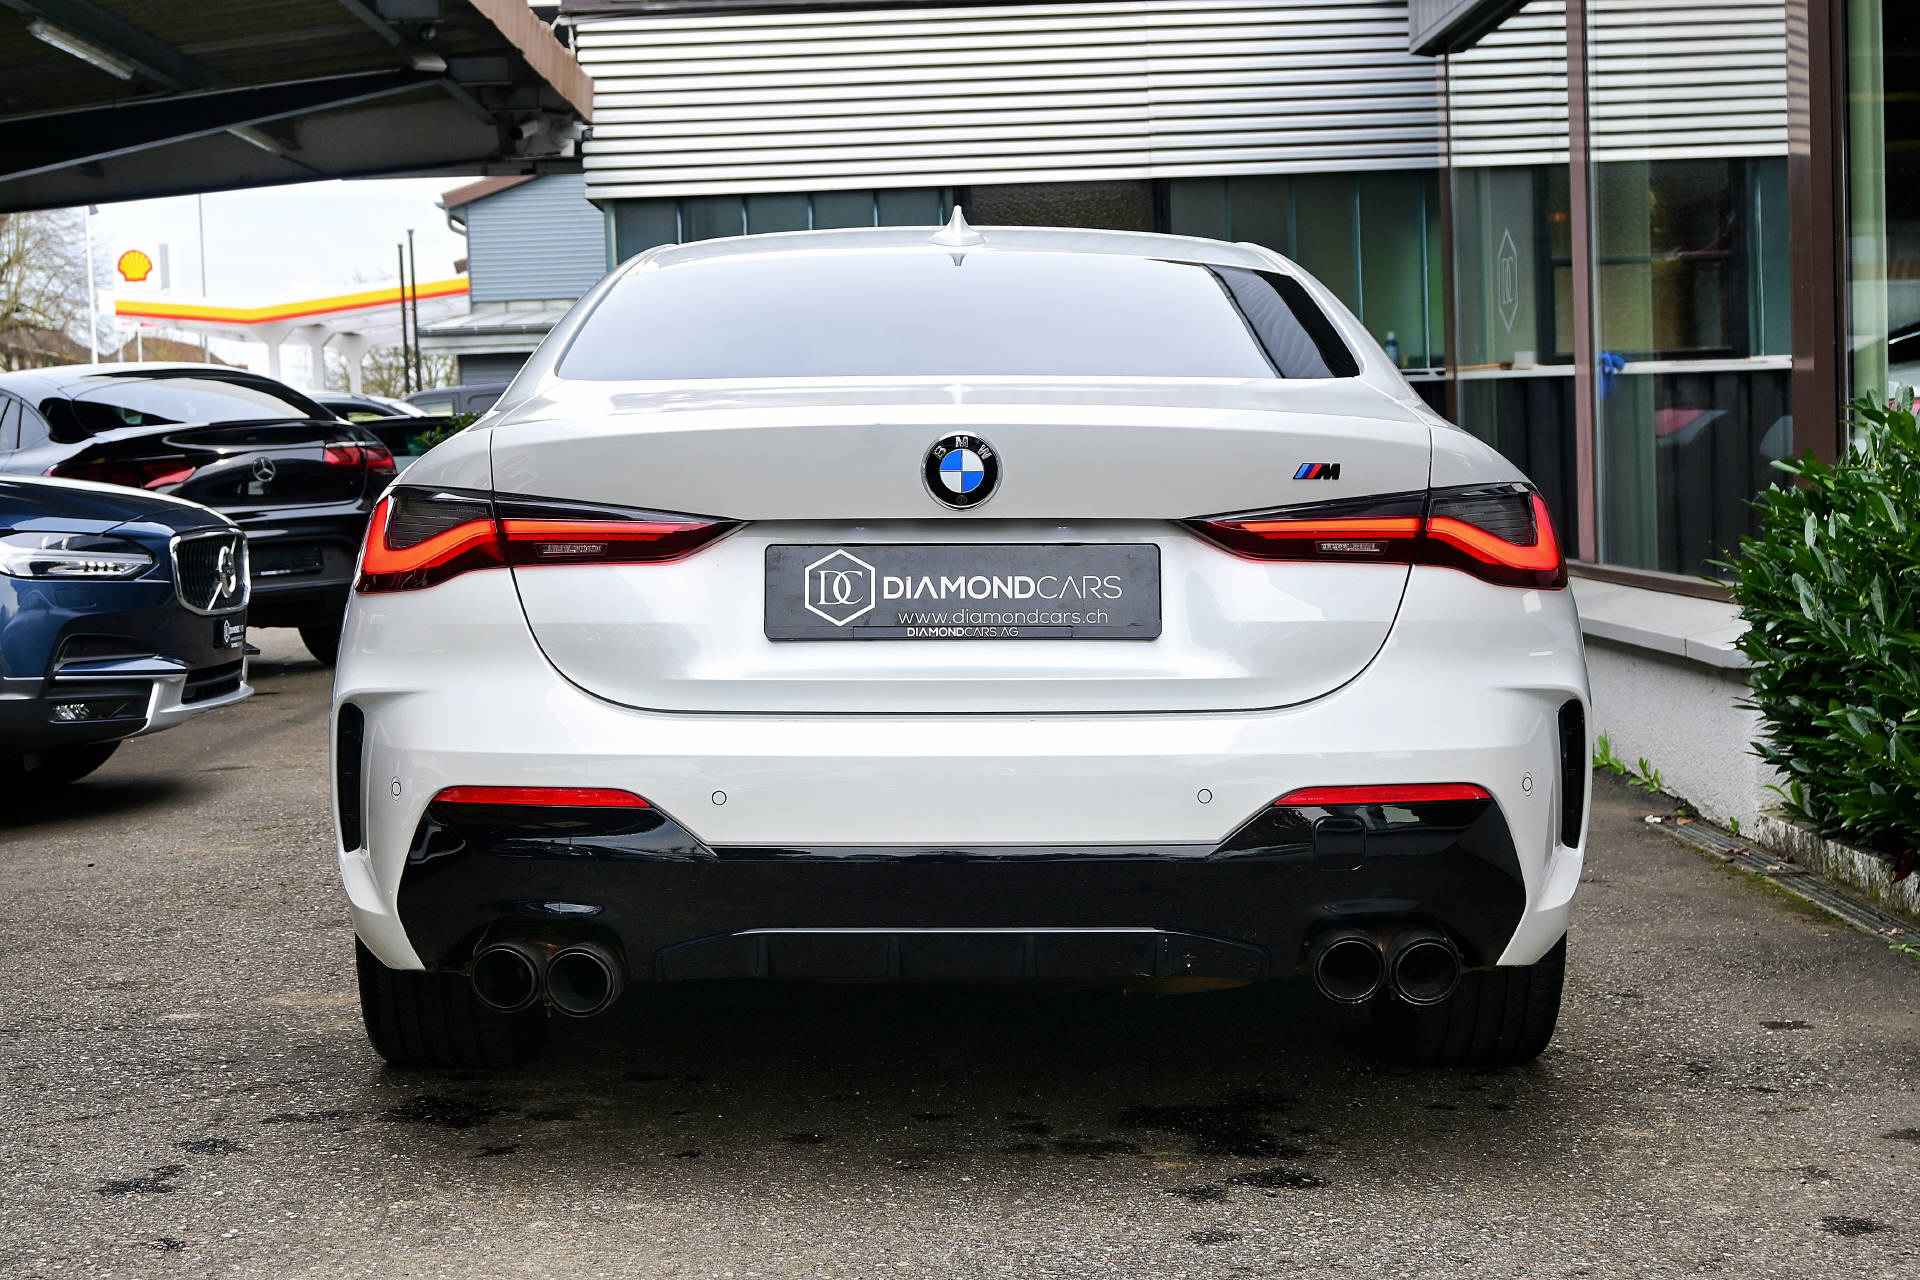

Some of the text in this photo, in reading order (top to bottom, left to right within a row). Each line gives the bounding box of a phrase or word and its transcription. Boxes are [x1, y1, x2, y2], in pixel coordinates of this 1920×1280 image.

[934, 436, 992, 460] BMW
[817, 570, 864, 605] DC
[883, 575, 1123, 599] DIAMONDCARS
[898, 608, 1108, 624] www.diamondcars.ch
[907, 627, 1019, 637] DIAMONDCARS AG
